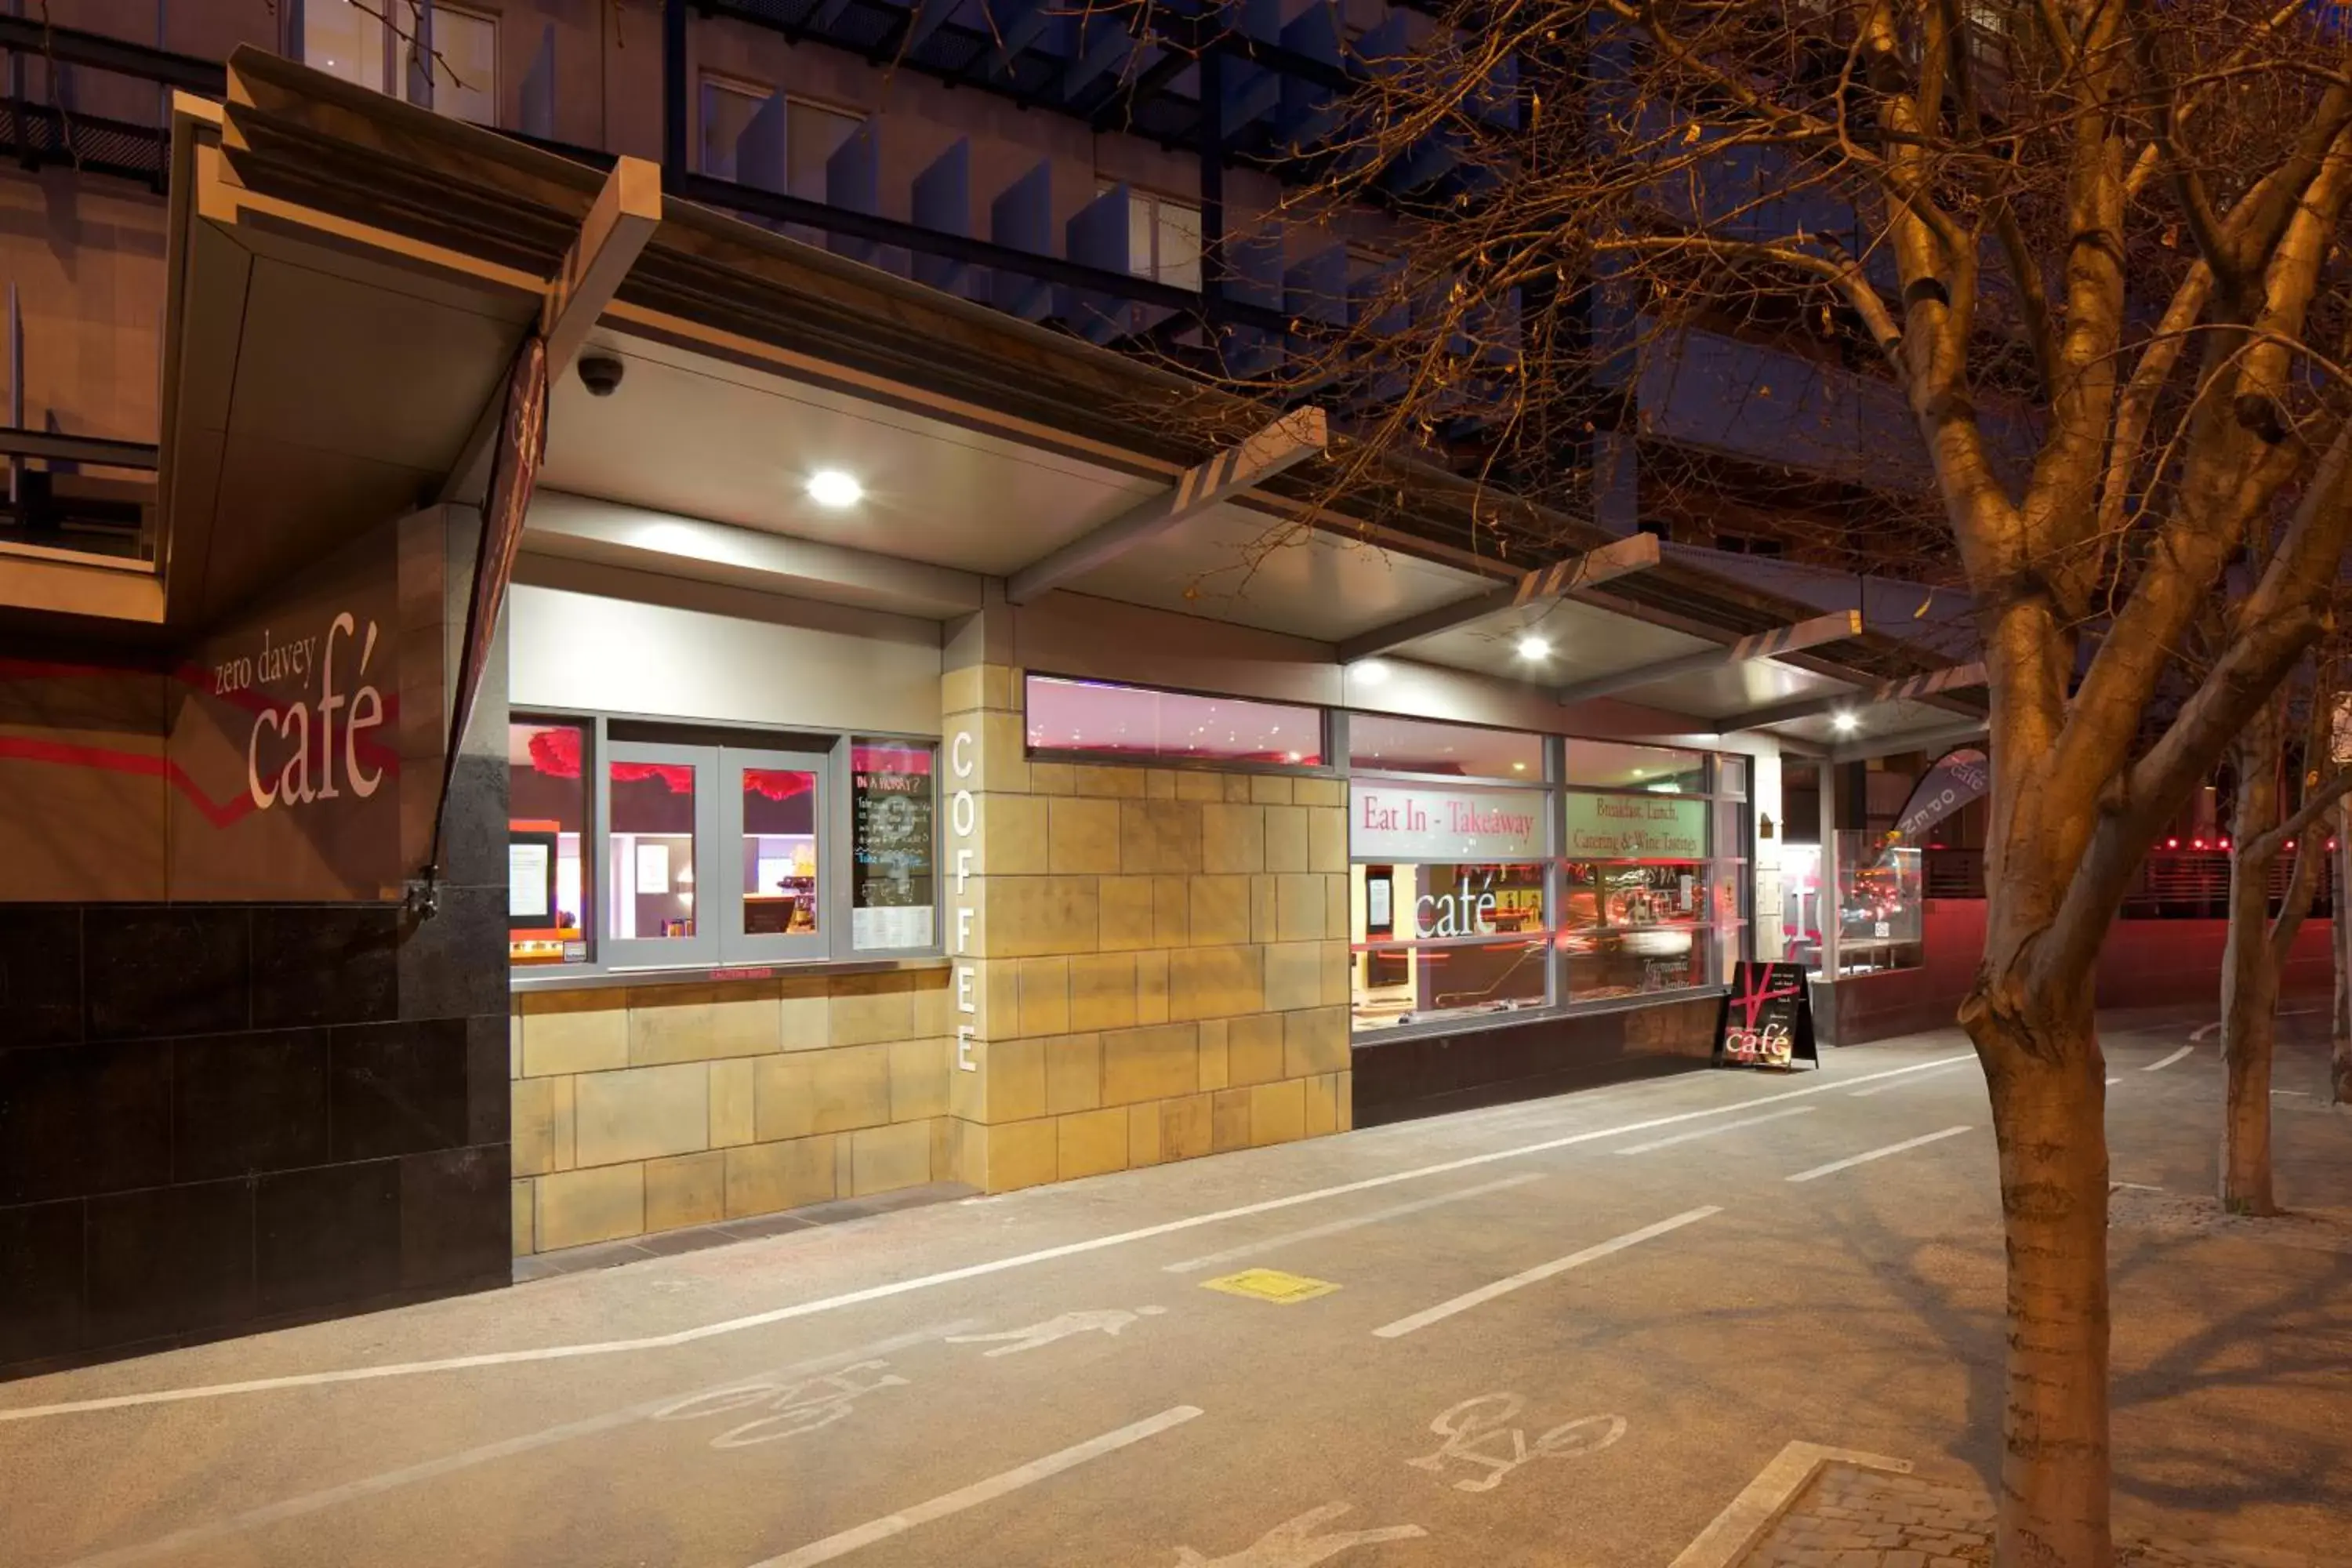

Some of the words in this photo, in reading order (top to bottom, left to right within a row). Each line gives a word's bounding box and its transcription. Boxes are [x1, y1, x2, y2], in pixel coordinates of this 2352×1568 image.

[216, 657, 252, 695] zero
[258, 629, 316, 689] davey
[249, 612, 383, 809] café
[1363, 795, 1399, 831] Eat
[1406, 798, 1427, 832] In
[1447, 800, 1534, 845] Takeaway
[1900, 789, 1955, 834] OPEN
[1573, 829, 1619, 855] Catering
[952, 731, 976, 1073] COFFEE
[1726, 1022, 1788, 1056] café
